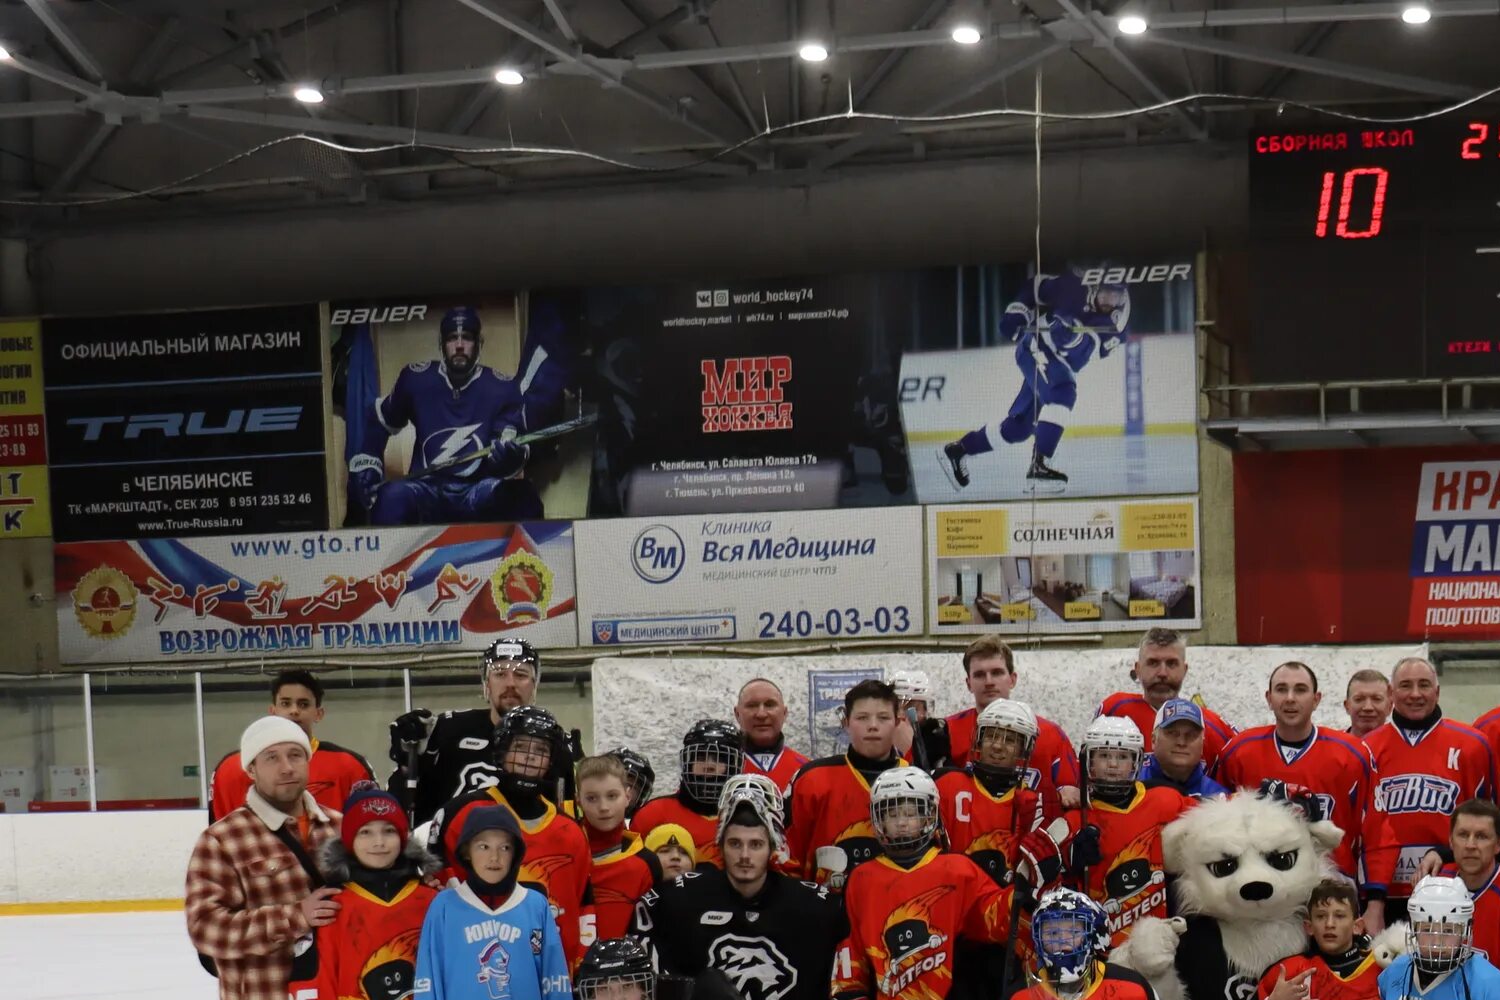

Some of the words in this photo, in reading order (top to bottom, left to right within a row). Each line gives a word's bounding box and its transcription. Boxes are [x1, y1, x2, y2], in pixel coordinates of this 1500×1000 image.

[1256, 131, 1348, 153] СБОРНАЯ
[1461, 122, 1489, 159] 2
[1315, 166, 1389, 239] 10
[1081, 264, 1191, 285] BAUER
[733, 288, 814, 304] world_hockey74
[331, 304, 427, 325] BAUER
[61, 333, 209, 360] ОФИЦИАЛЬНЫЙ
[215, 331, 301, 351] МАГАЗИН
[701, 356, 792, 405] МИР
[66, 406, 303, 441] TRUE
[702, 402, 793, 433] ХОККЕЯ
[13, 424, 25, 436] 11
[28, 423, 40, 436] 93
[135, 471, 253, 492] ЧЕЛЯБИНСКЕ
[68, 503, 82, 515] ТК
[85, 499, 172, 514] «МАРКШТАДТ»,
[175, 499, 197, 510] СЕК
[200, 498, 219, 509] 205
[229, 496, 237, 507] 8
[239, 496, 257, 507] 951
[261, 494, 280, 506] 235
[283, 494, 296, 505] 32
[299, 493, 312, 504] 46
[138, 517, 243, 530] www.True-Russia.ru
[701, 520, 772, 536] Клиника
[1013, 526, 1115, 543] СОЛНЕЧНАЯ
[231, 534, 380, 559] www.gto.ru
[702, 541, 744, 563] Вся
[747, 536, 876, 561] Медицина
[620, 626, 688, 639] МЕДИЦИНСКИЙ
[691, 624, 720, 637] ЦЕНТР
[758, 606, 911, 639] 240-03-03
[159, 624, 313, 655] ВОЗРОЖДАЯ
[320, 619, 461, 648] ТРАДИЦИИ
[1447, 747, 1460, 771] К
